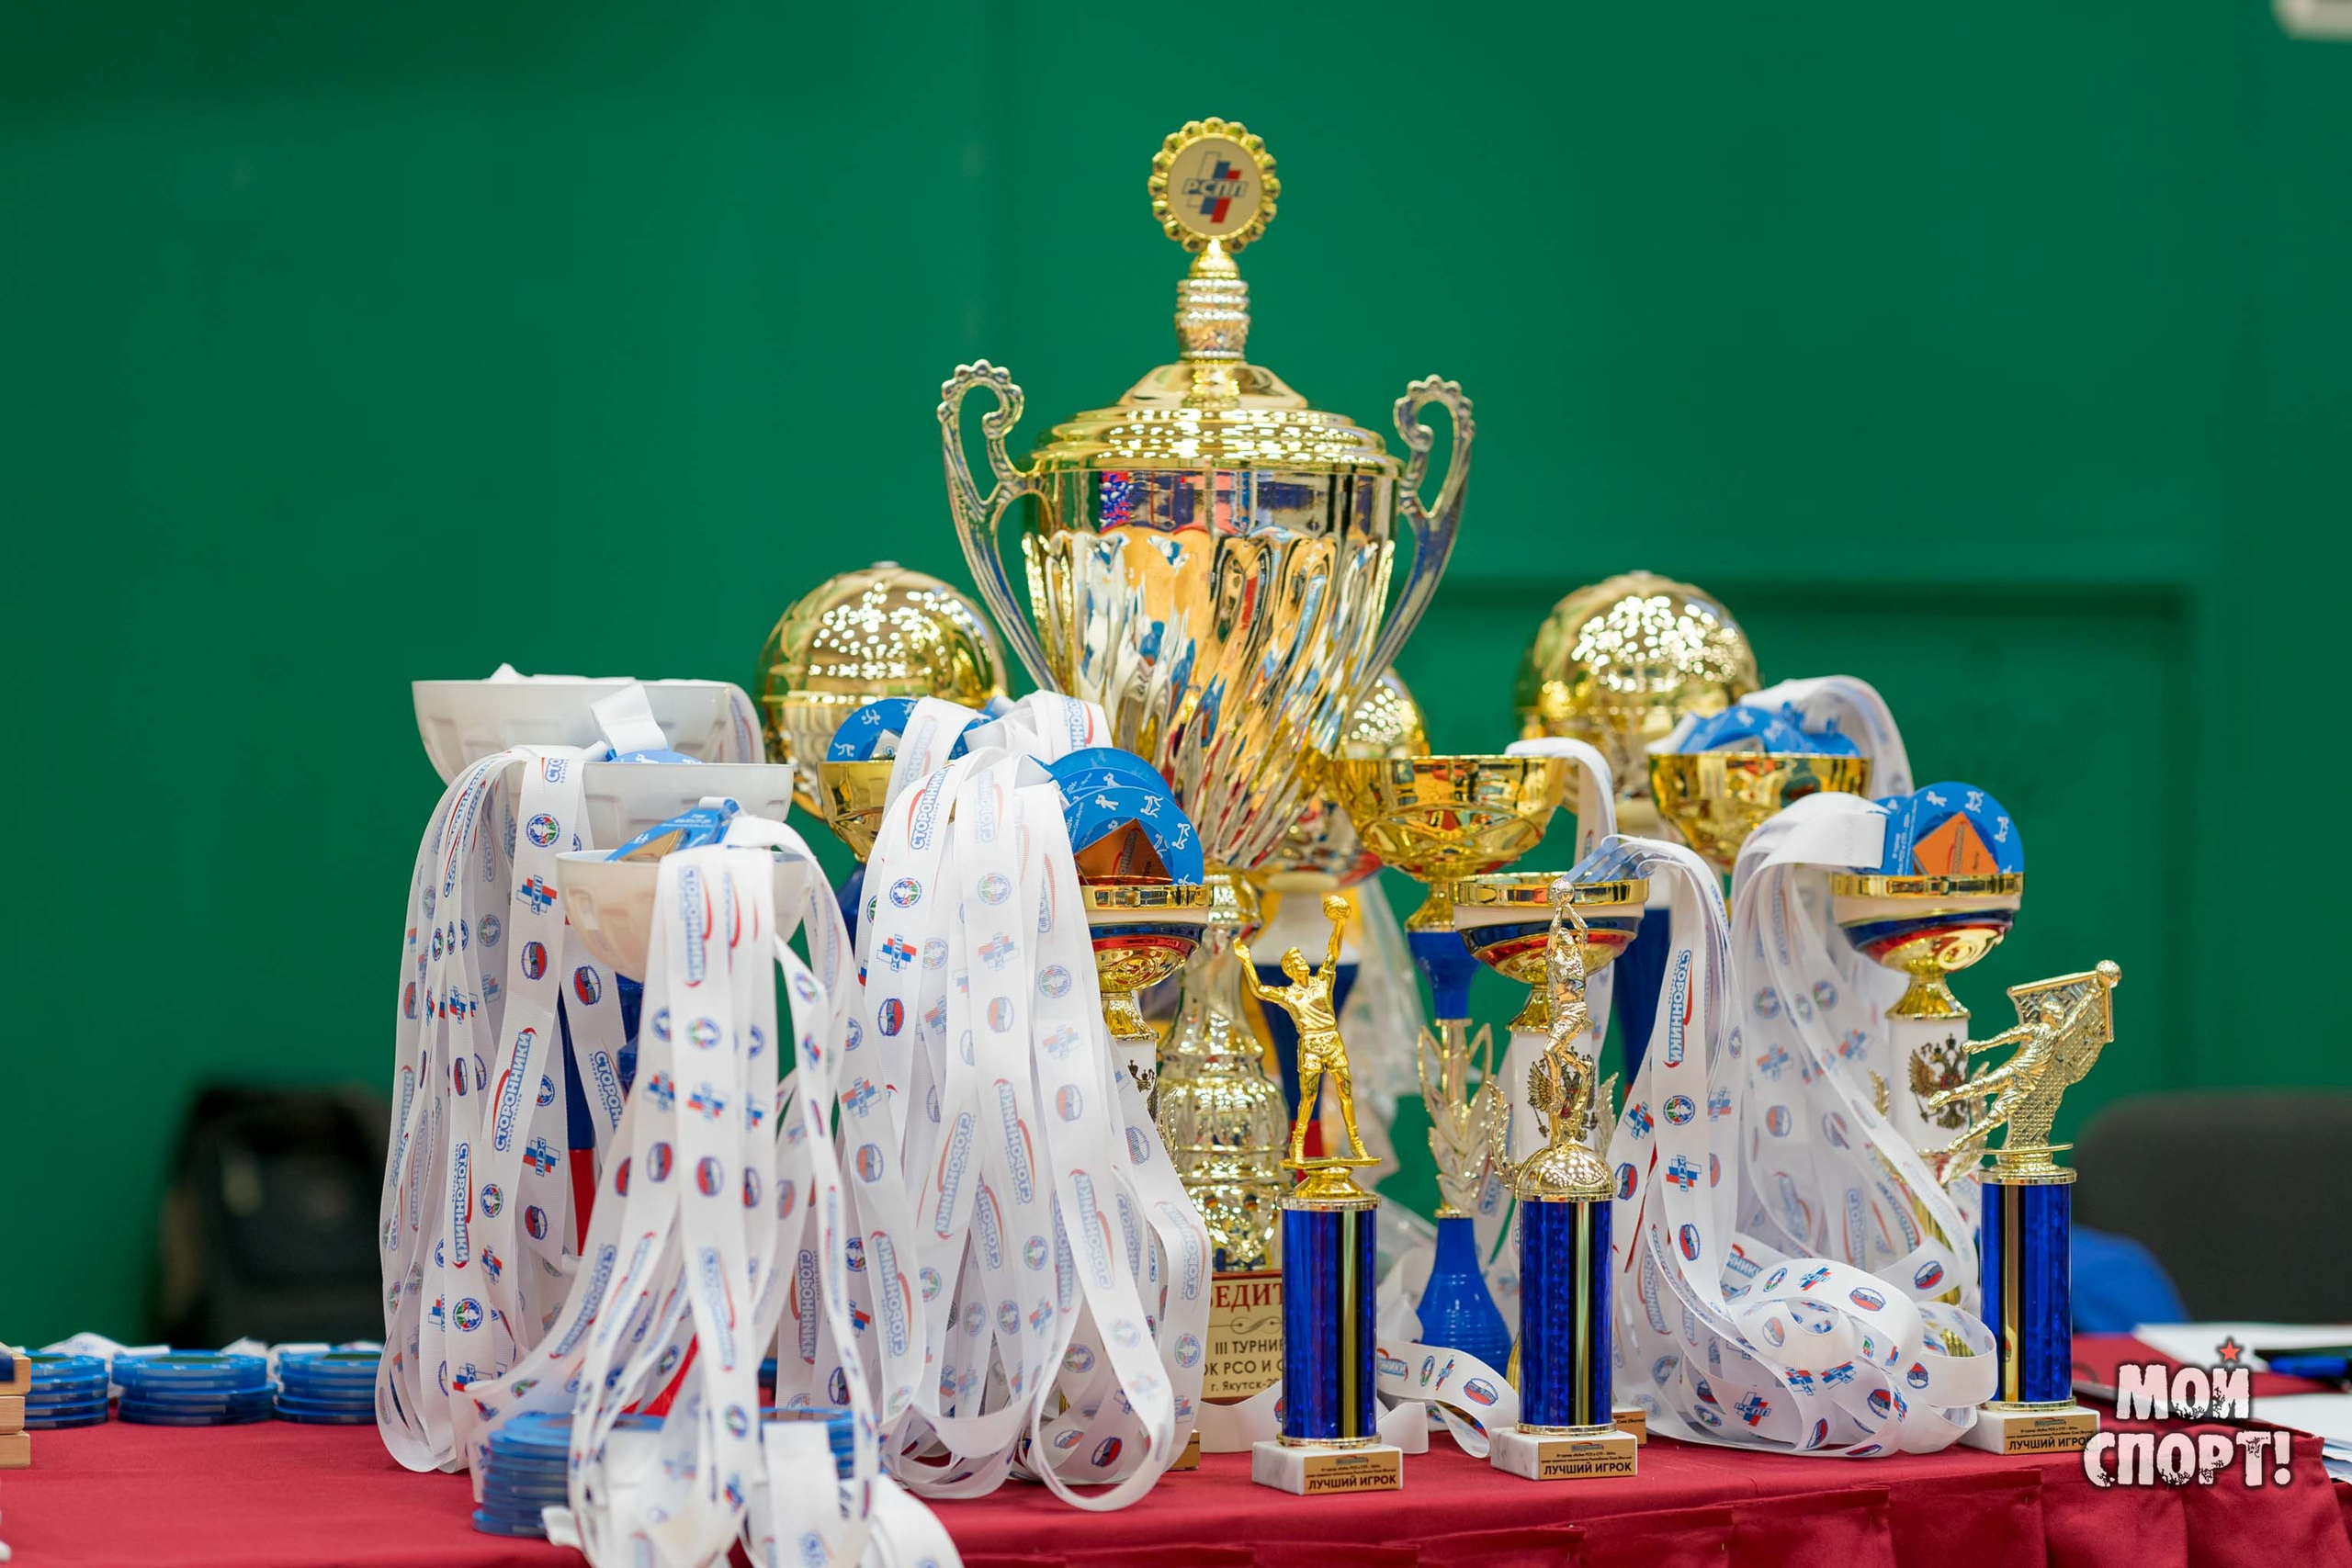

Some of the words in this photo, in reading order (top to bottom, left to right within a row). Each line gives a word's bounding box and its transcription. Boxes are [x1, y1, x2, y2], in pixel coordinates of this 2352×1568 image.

[1182, 177, 1250, 197] РСПП
[530, 874, 544, 916] РСПП
[890, 933, 904, 973] РСПП
[1668, 949, 1691, 1063] СТОРОННИКИ
[494, 1032, 532, 1152] СТОРОННИКИ
[594, 1051, 624, 1134] СТОРОН
[1630, 1101, 1649, 1140] РСПП
[536, 1136, 547, 1178] РСПП
[1677, 1155, 1689, 1192] РСПП
[453, 1143, 470, 1262] СТОРОННИКИ
[1799, 1271, 1831, 1283] РСПП
[1210, 1282, 1283, 1313] ЕДИТ
[1224, 1360, 1256, 1375] РСО
[1261, 1359, 1272, 1372] И
[1734, 1402, 1772, 1417] РСПП
[2008, 1437, 2055, 1450] ЛУЧШИЙ
[1308, 1475, 1357, 1490] ЛУЧШИЙ
[1360, 1474, 1396, 1486] ИГРОК
[1544, 1461, 1592, 1475] ЛУЧШИЙ
[1595, 1462, 1632, 1472] ИГРОК
